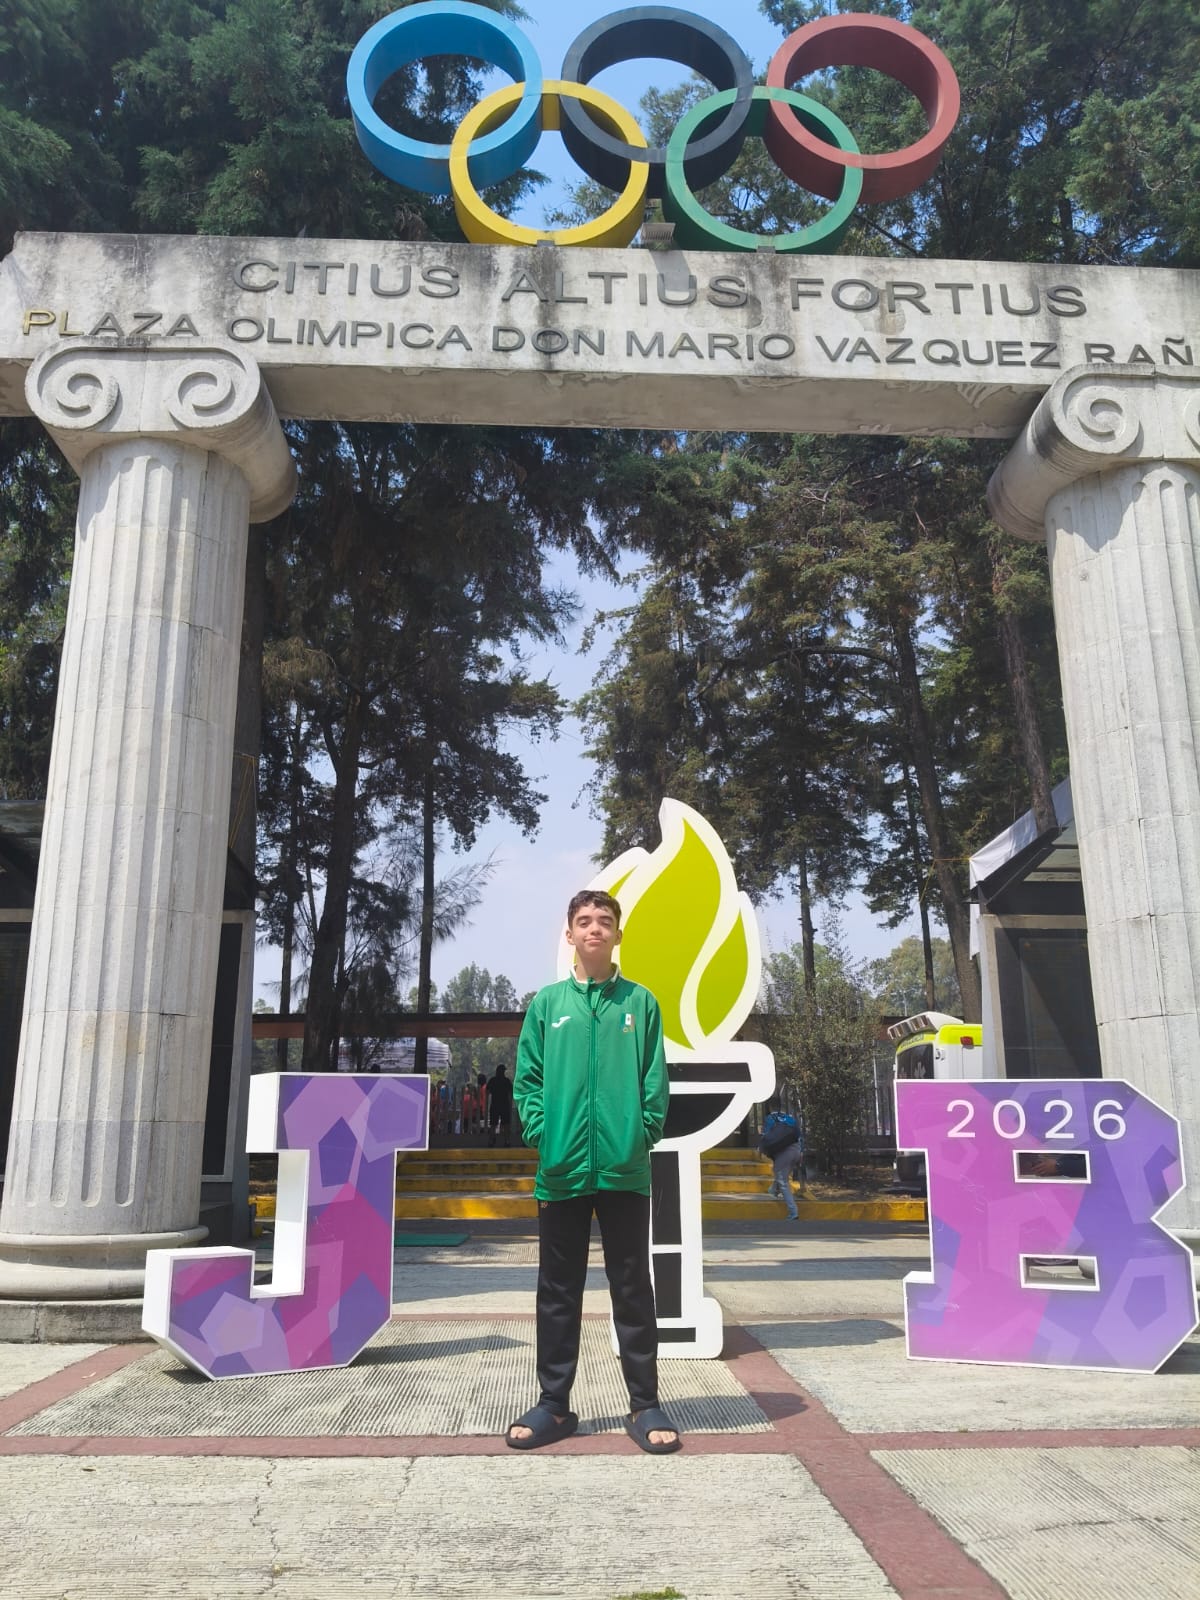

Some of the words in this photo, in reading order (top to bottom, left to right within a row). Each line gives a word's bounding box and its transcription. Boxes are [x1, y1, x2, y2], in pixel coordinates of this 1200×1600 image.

[233, 259, 460, 297] CITIUS
[501, 271, 748, 308] ALTIUS
[791, 278, 1088, 317] FORTIUS
[23, 310, 199, 336] PLAZA
[226, 317, 472, 351] OLIMPICA
[492, 326, 605, 355] DON
[626, 330, 795, 360] MARIO
[815, 335, 1060, 367] VAZQUEZ
[946, 1099, 1127, 1140] 2026
